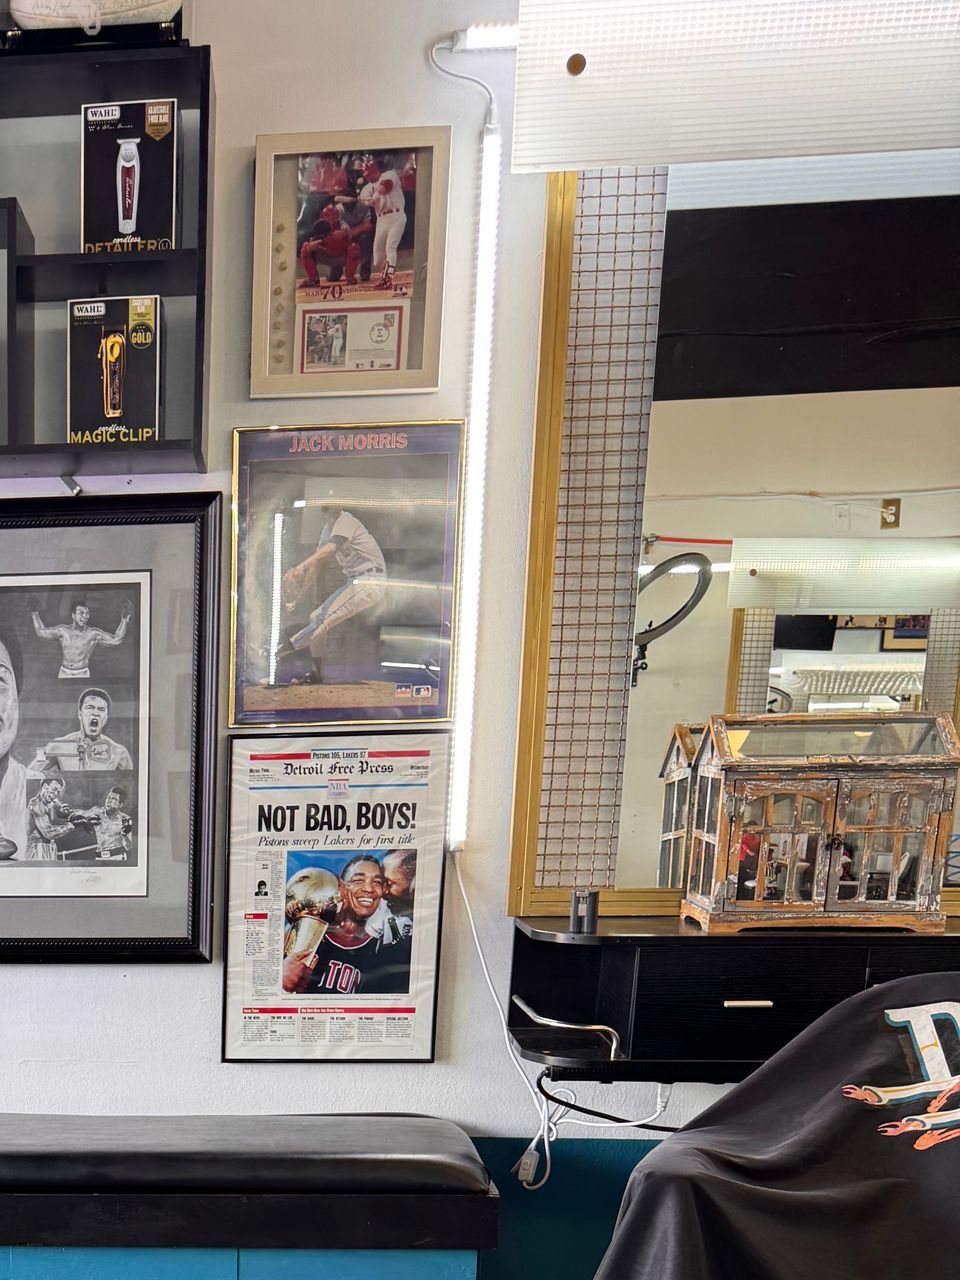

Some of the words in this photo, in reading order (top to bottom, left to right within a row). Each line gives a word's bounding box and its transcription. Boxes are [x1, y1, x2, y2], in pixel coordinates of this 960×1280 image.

[90, 109, 117, 118] WAHL
[76, 305, 102, 314] WAHL
[131, 331, 152, 344] GOLD
[70, 429, 116, 444] MAGIC
[119, 427, 153, 442] CLIP
[288, 434, 334, 453] JACK
[338, 432, 408, 451] MORRIS
[283, 761, 323, 776] Detroit
[328, 761, 355, 775] Free
[357, 760, 394, 774] Press
[257, 804, 300, 833] NOT
[305, 803, 351, 833] BAD,
[356, 802, 418, 831] BOYS!
[258, 836, 289, 847] Pistons
[291, 838, 319, 850] sweep
[323, 834, 354, 846] Lakers
[358, 833, 374, 849] for
[375, 832, 395, 849] first
[398, 833, 416, 845] title
